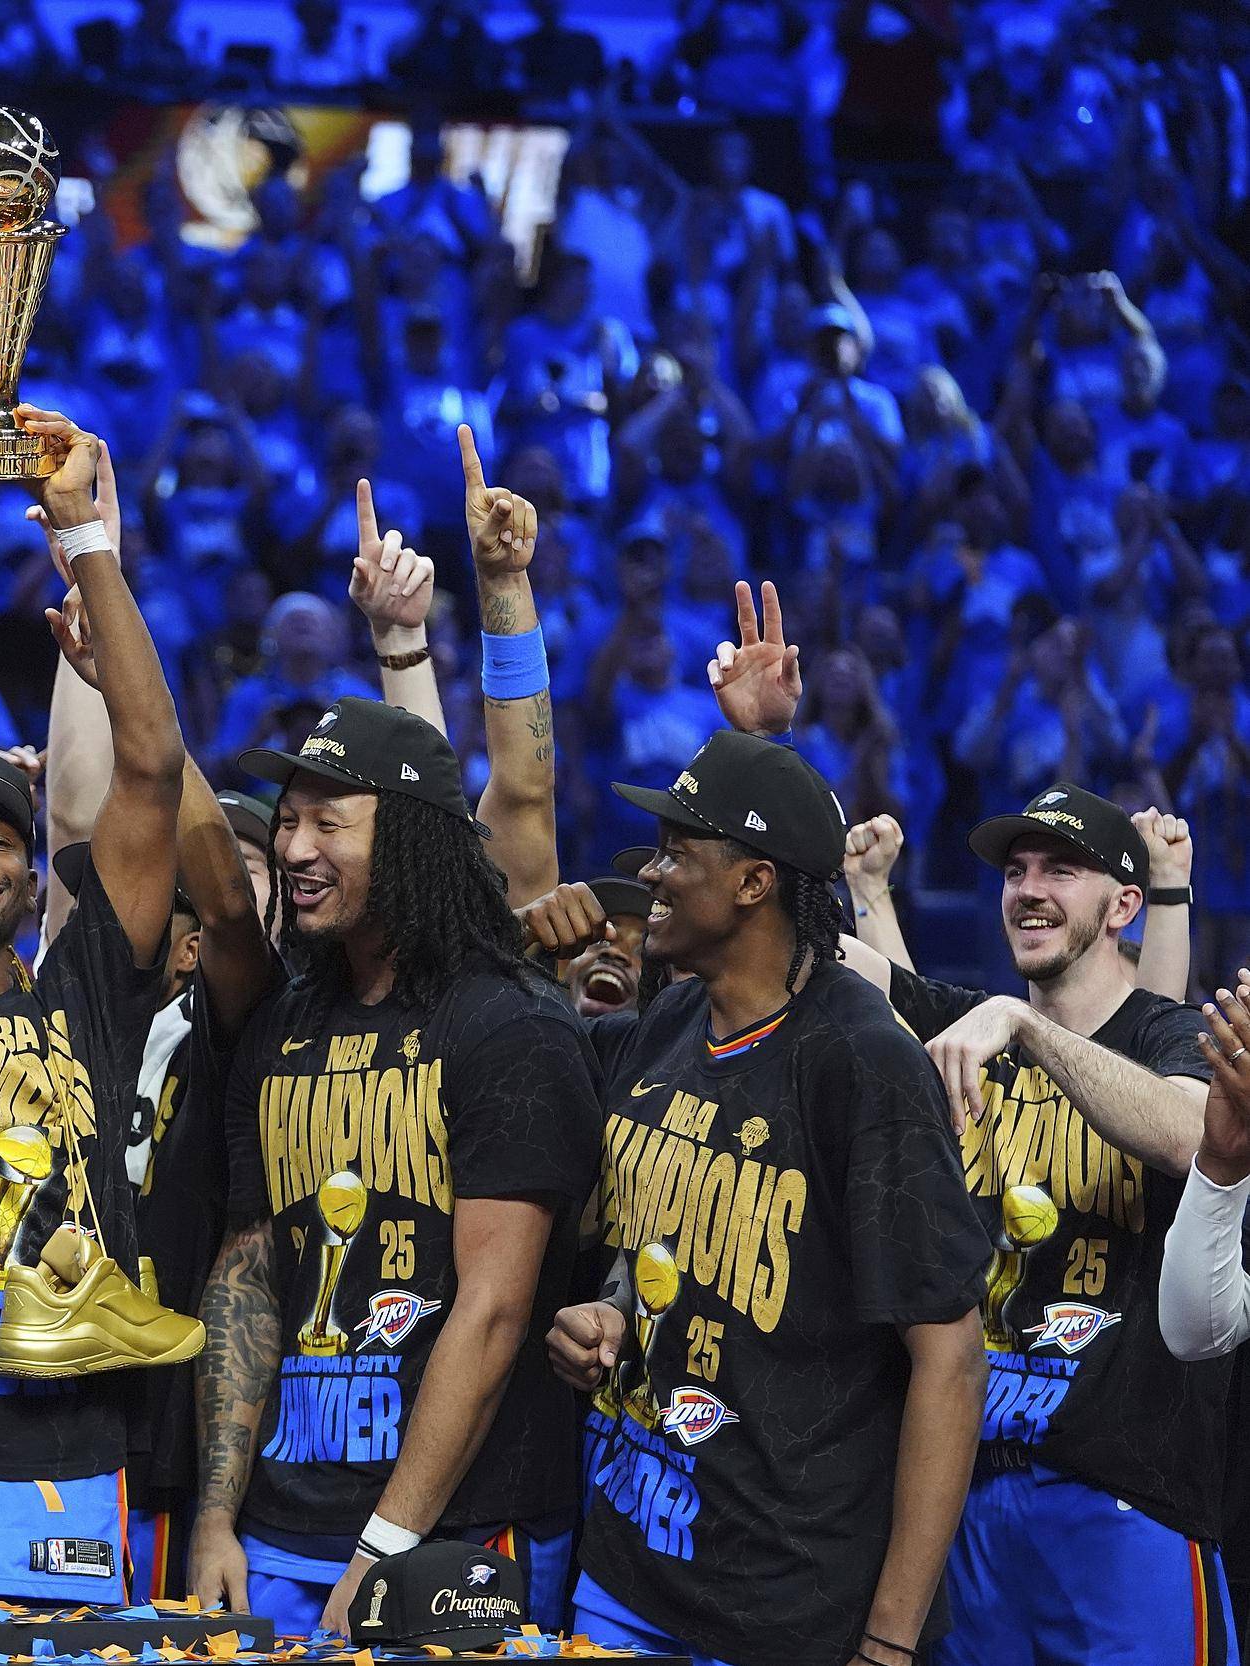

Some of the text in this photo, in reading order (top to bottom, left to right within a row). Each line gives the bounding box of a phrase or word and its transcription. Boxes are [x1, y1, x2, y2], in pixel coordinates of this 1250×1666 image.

[325, 1032, 378, 1073] NBA
[660, 1089, 720, 1143] NBA
[380, 1219, 416, 1280] 25
[1062, 1238, 1109, 1297] 25
[371, 1303, 409, 1334] OKC
[1041, 1314, 1094, 1341] OKC
[355, 1354, 402, 1373] CITY
[686, 1314, 725, 1383] 25
[1030, 1355, 1081, 1377] CITY
[667, 1402, 716, 1427] OKC
[430, 1588, 520, 1619] Champions
